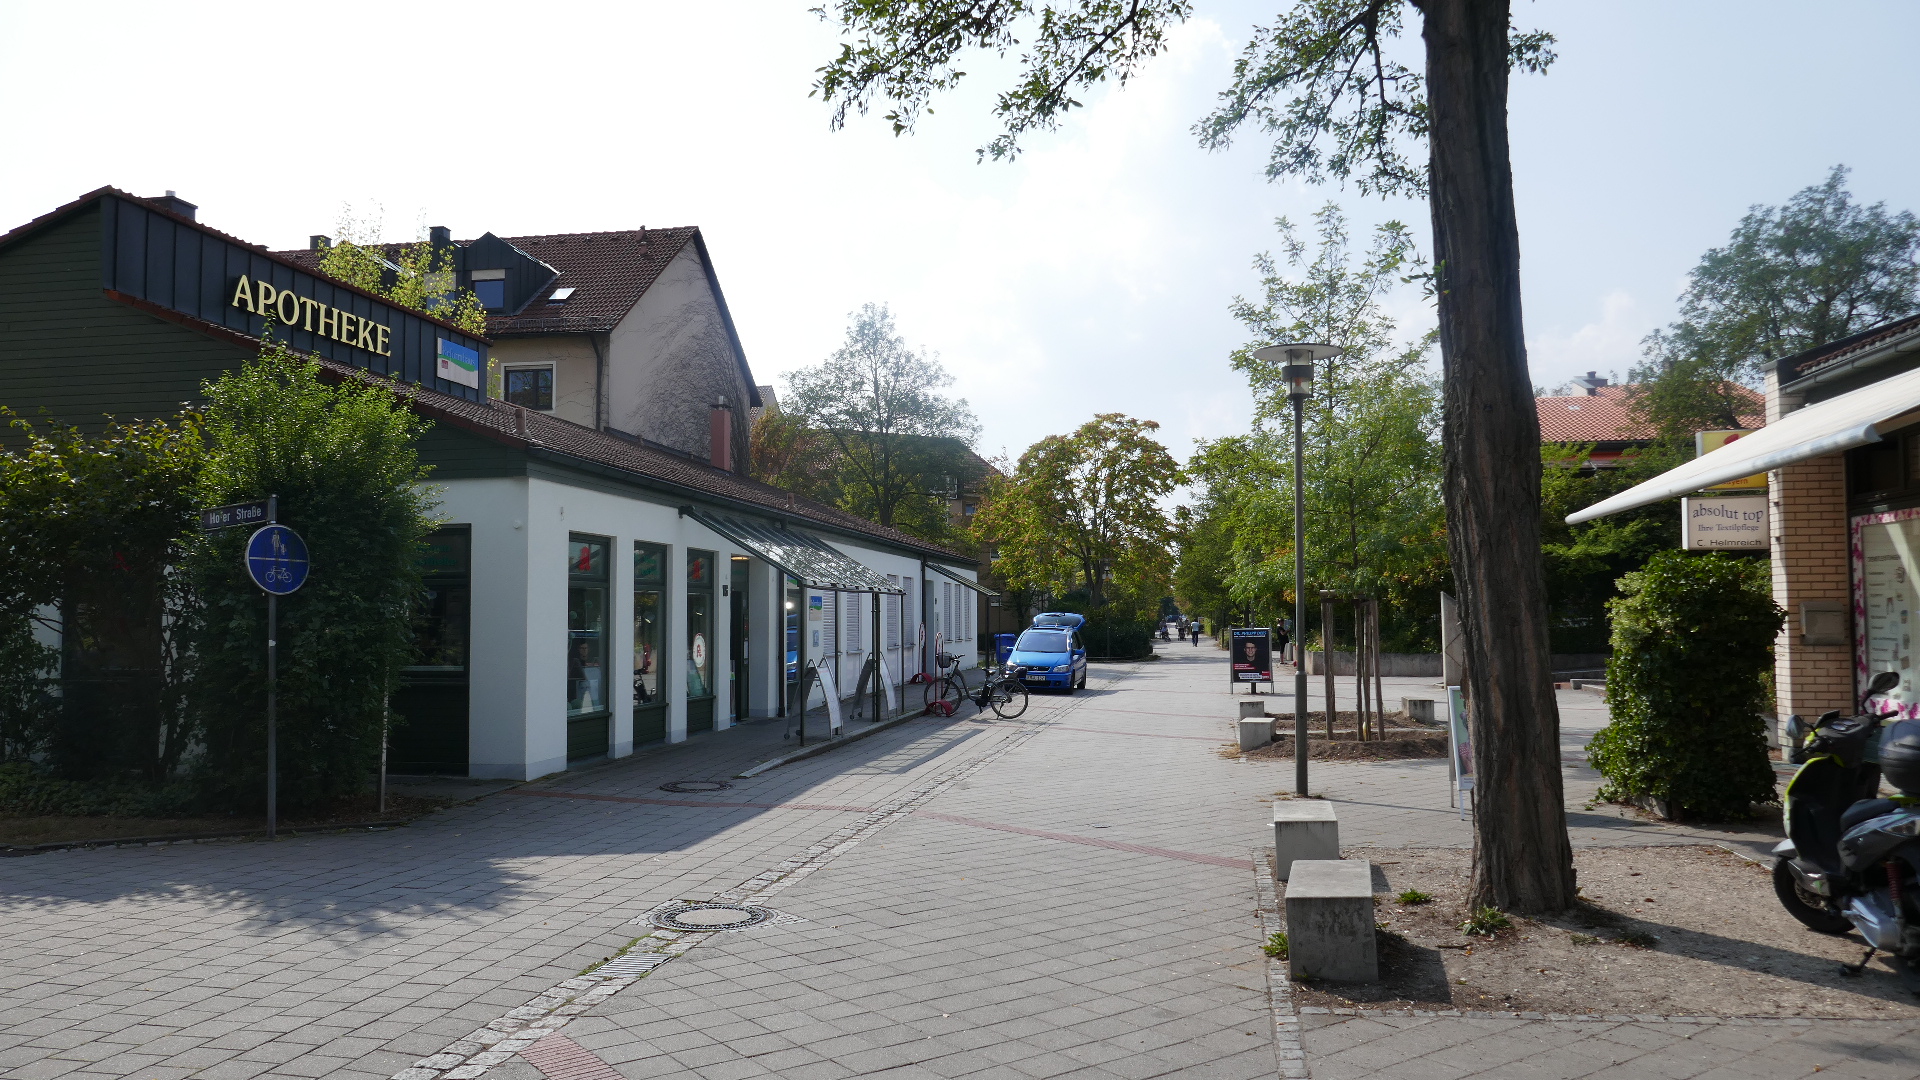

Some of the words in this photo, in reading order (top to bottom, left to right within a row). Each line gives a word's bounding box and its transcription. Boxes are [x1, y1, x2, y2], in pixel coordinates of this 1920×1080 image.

[232, 274, 392, 357] APOTHEKE
[209, 512, 231, 524] Hoer
[236, 505, 262, 520] Straße
[1692, 503, 1738, 519] absolut
[1743, 510, 1764, 522] top
[1698, 524, 1713, 532] Ihre
[1716, 523, 1759, 532] Textilpflege
[1697, 539, 1706, 547] C.
